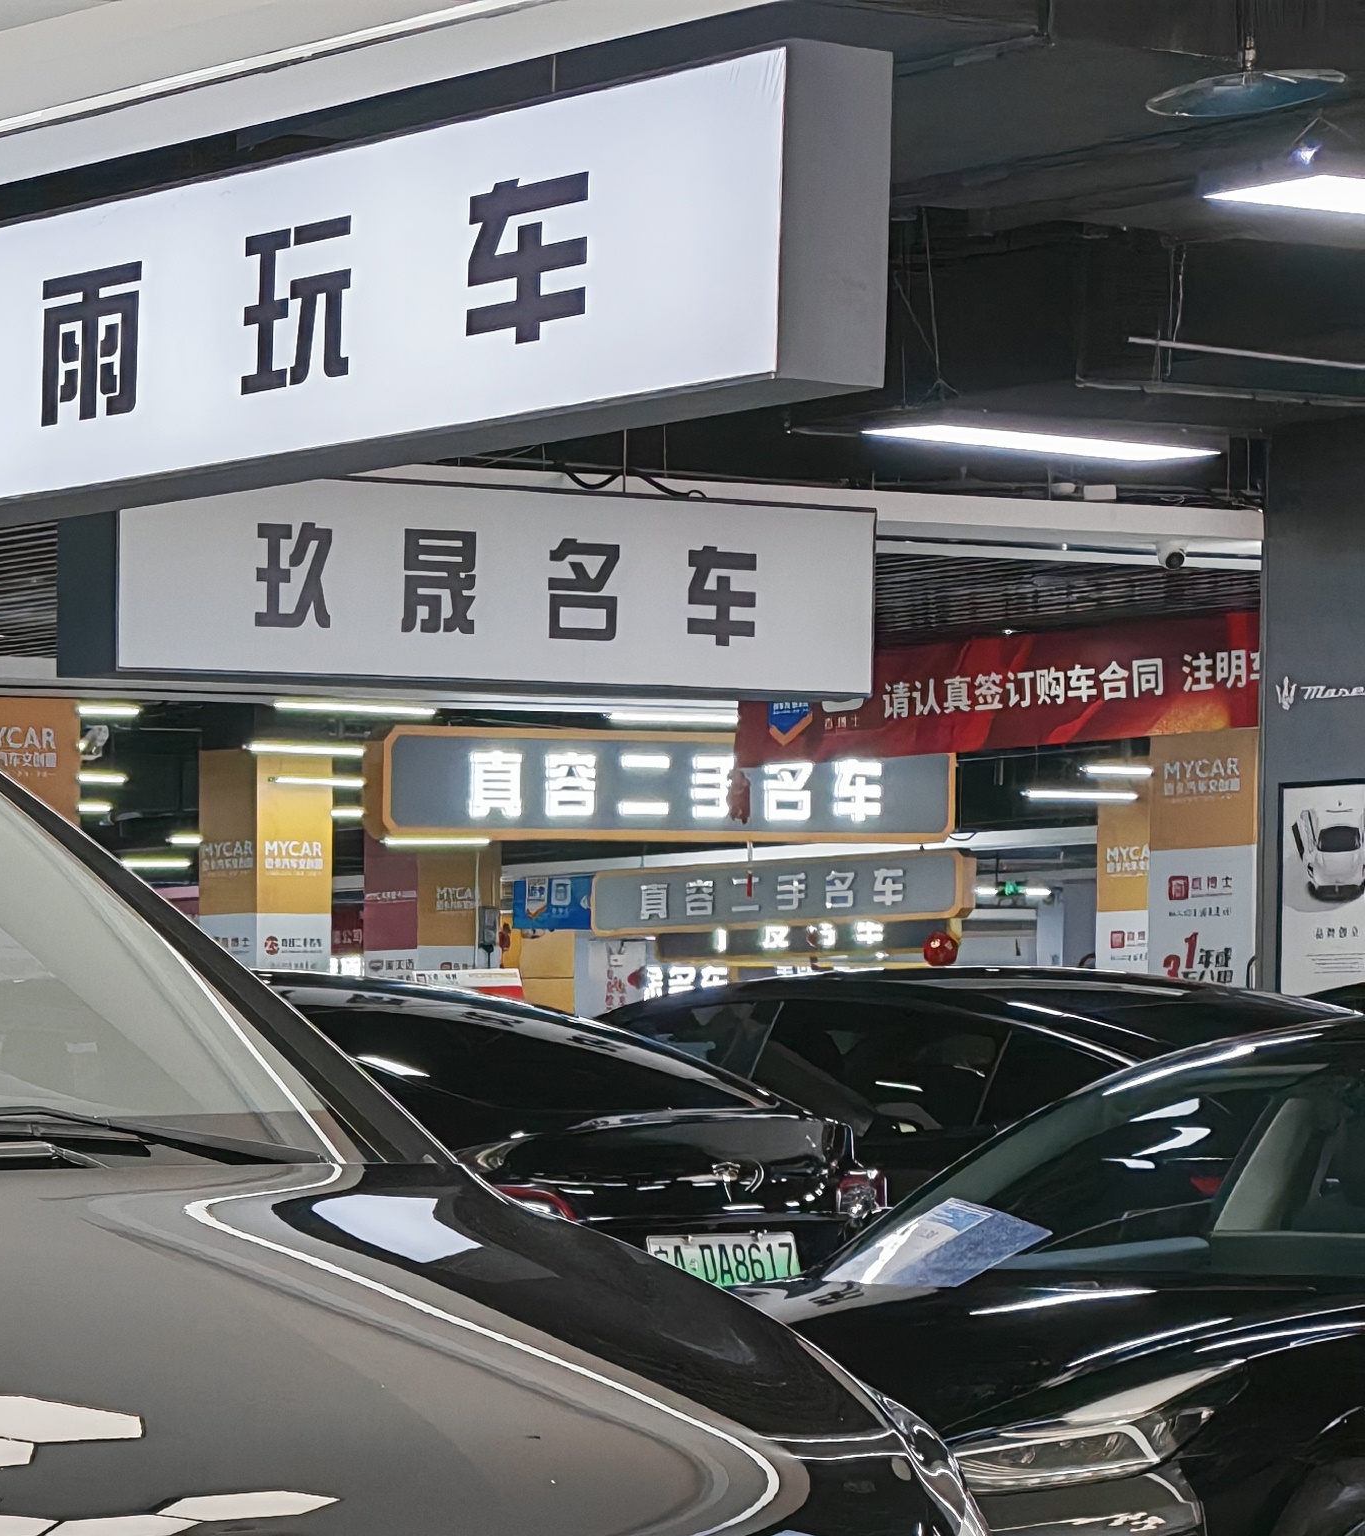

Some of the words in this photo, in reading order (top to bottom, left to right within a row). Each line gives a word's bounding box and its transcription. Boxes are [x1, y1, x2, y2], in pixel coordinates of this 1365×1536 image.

[253, 522, 758, 646] 玖晟名车
[882, 657, 1164, 719] 请认真签订购车合同
[468, 750, 883, 823] 真容二手名车
[1163, 758, 1240, 781] MYCAR
[202, 840, 253, 857] MYCAR
[264, 840, 322, 857] MYCAR
[639, 869, 904, 921] 真容二手名车
[699, 1242, 793, 1285] DA8617
